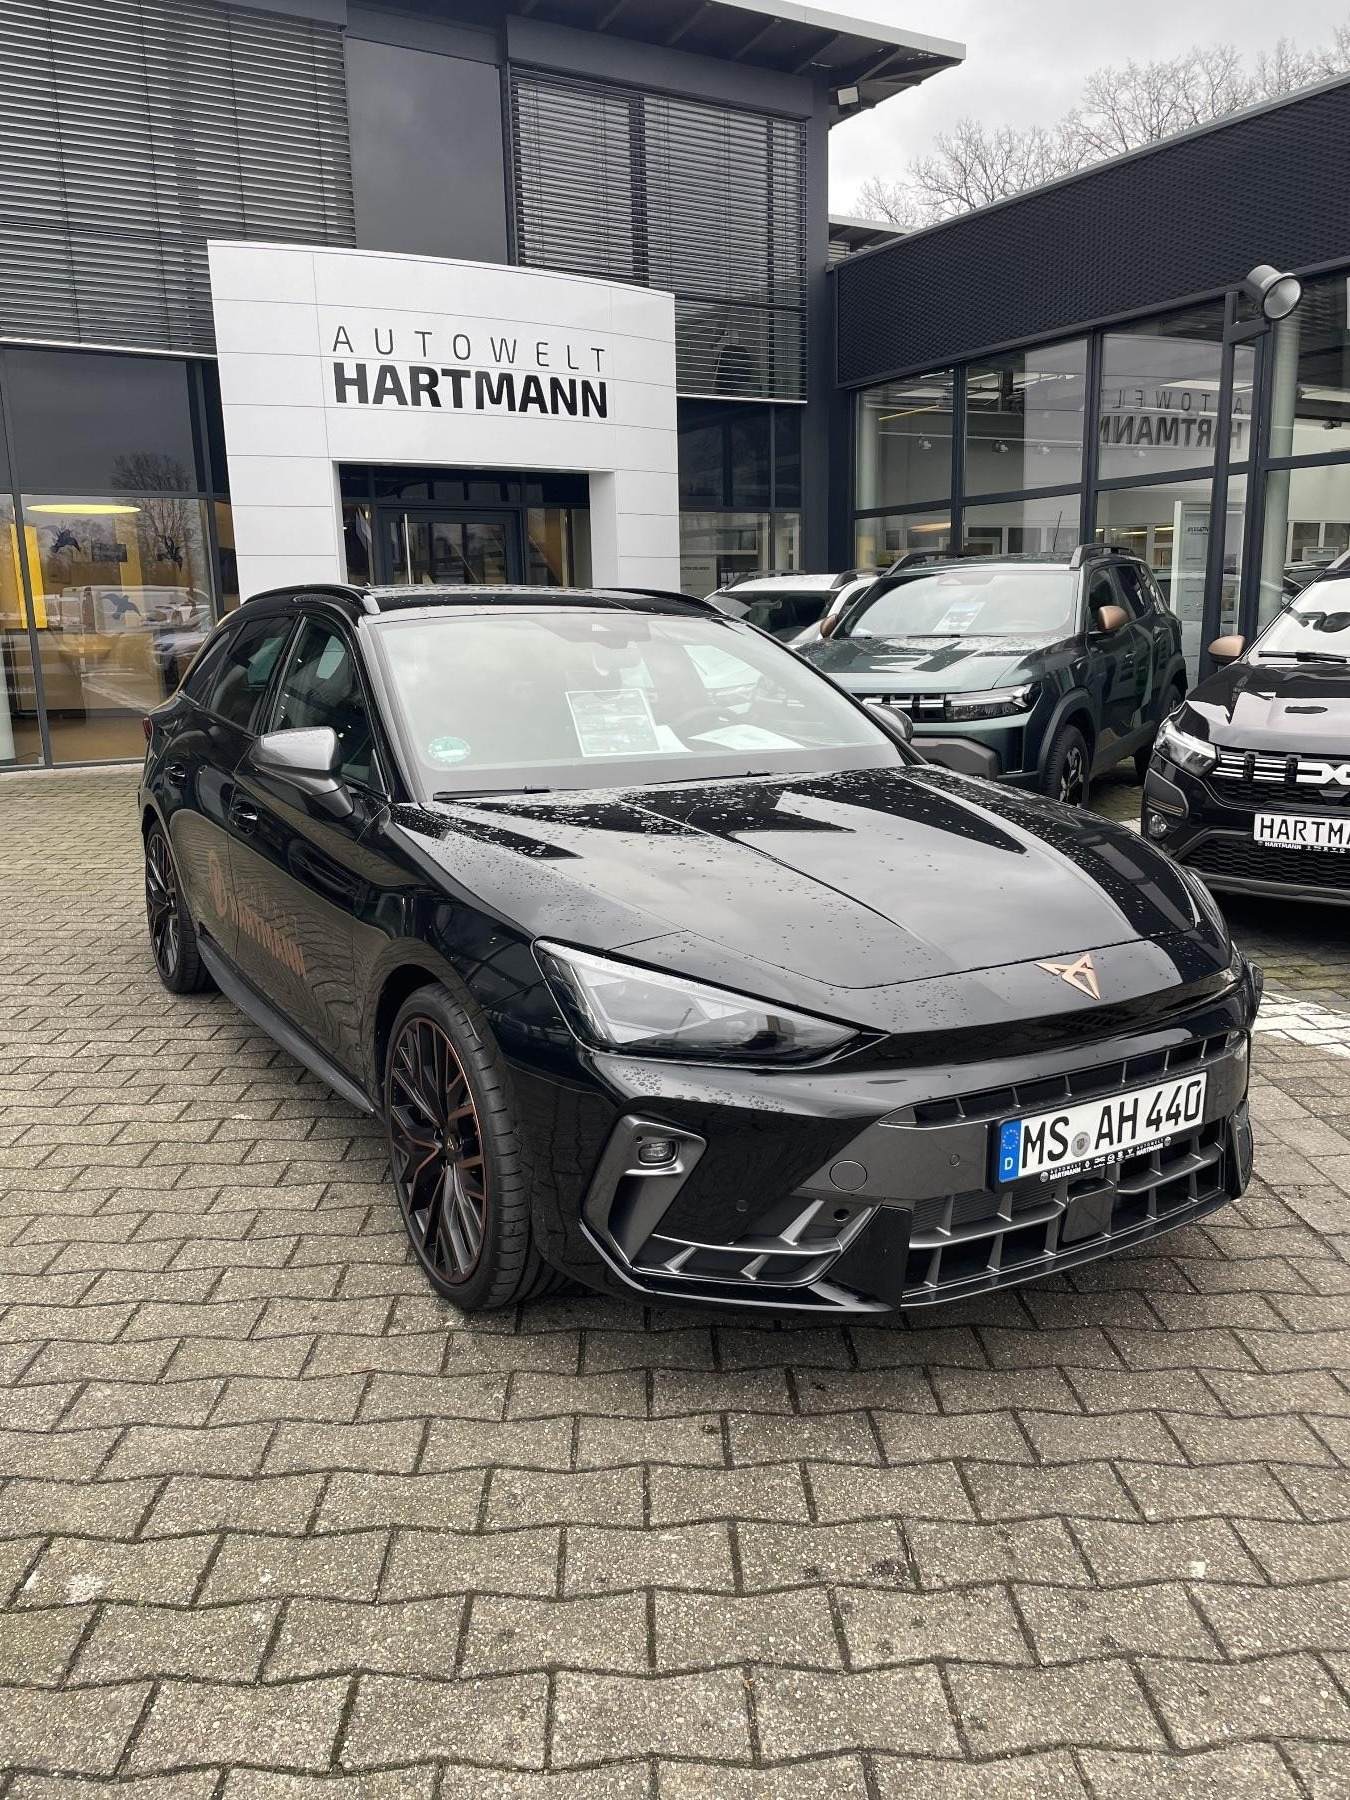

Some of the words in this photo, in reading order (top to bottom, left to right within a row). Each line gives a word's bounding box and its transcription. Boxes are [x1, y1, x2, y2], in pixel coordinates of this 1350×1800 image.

[333, 326, 605, 372] AUTOWELT
[333, 362, 607, 419] HARTMANN
[1264, 841, 1302, 850] HARTMANN
[1022, 1116, 1069, 1169] MS
[1094, 1097, 1139, 1150] AH
[1145, 1079, 1202, 1133] 440
[1004, 1157, 1013, 1170] D
